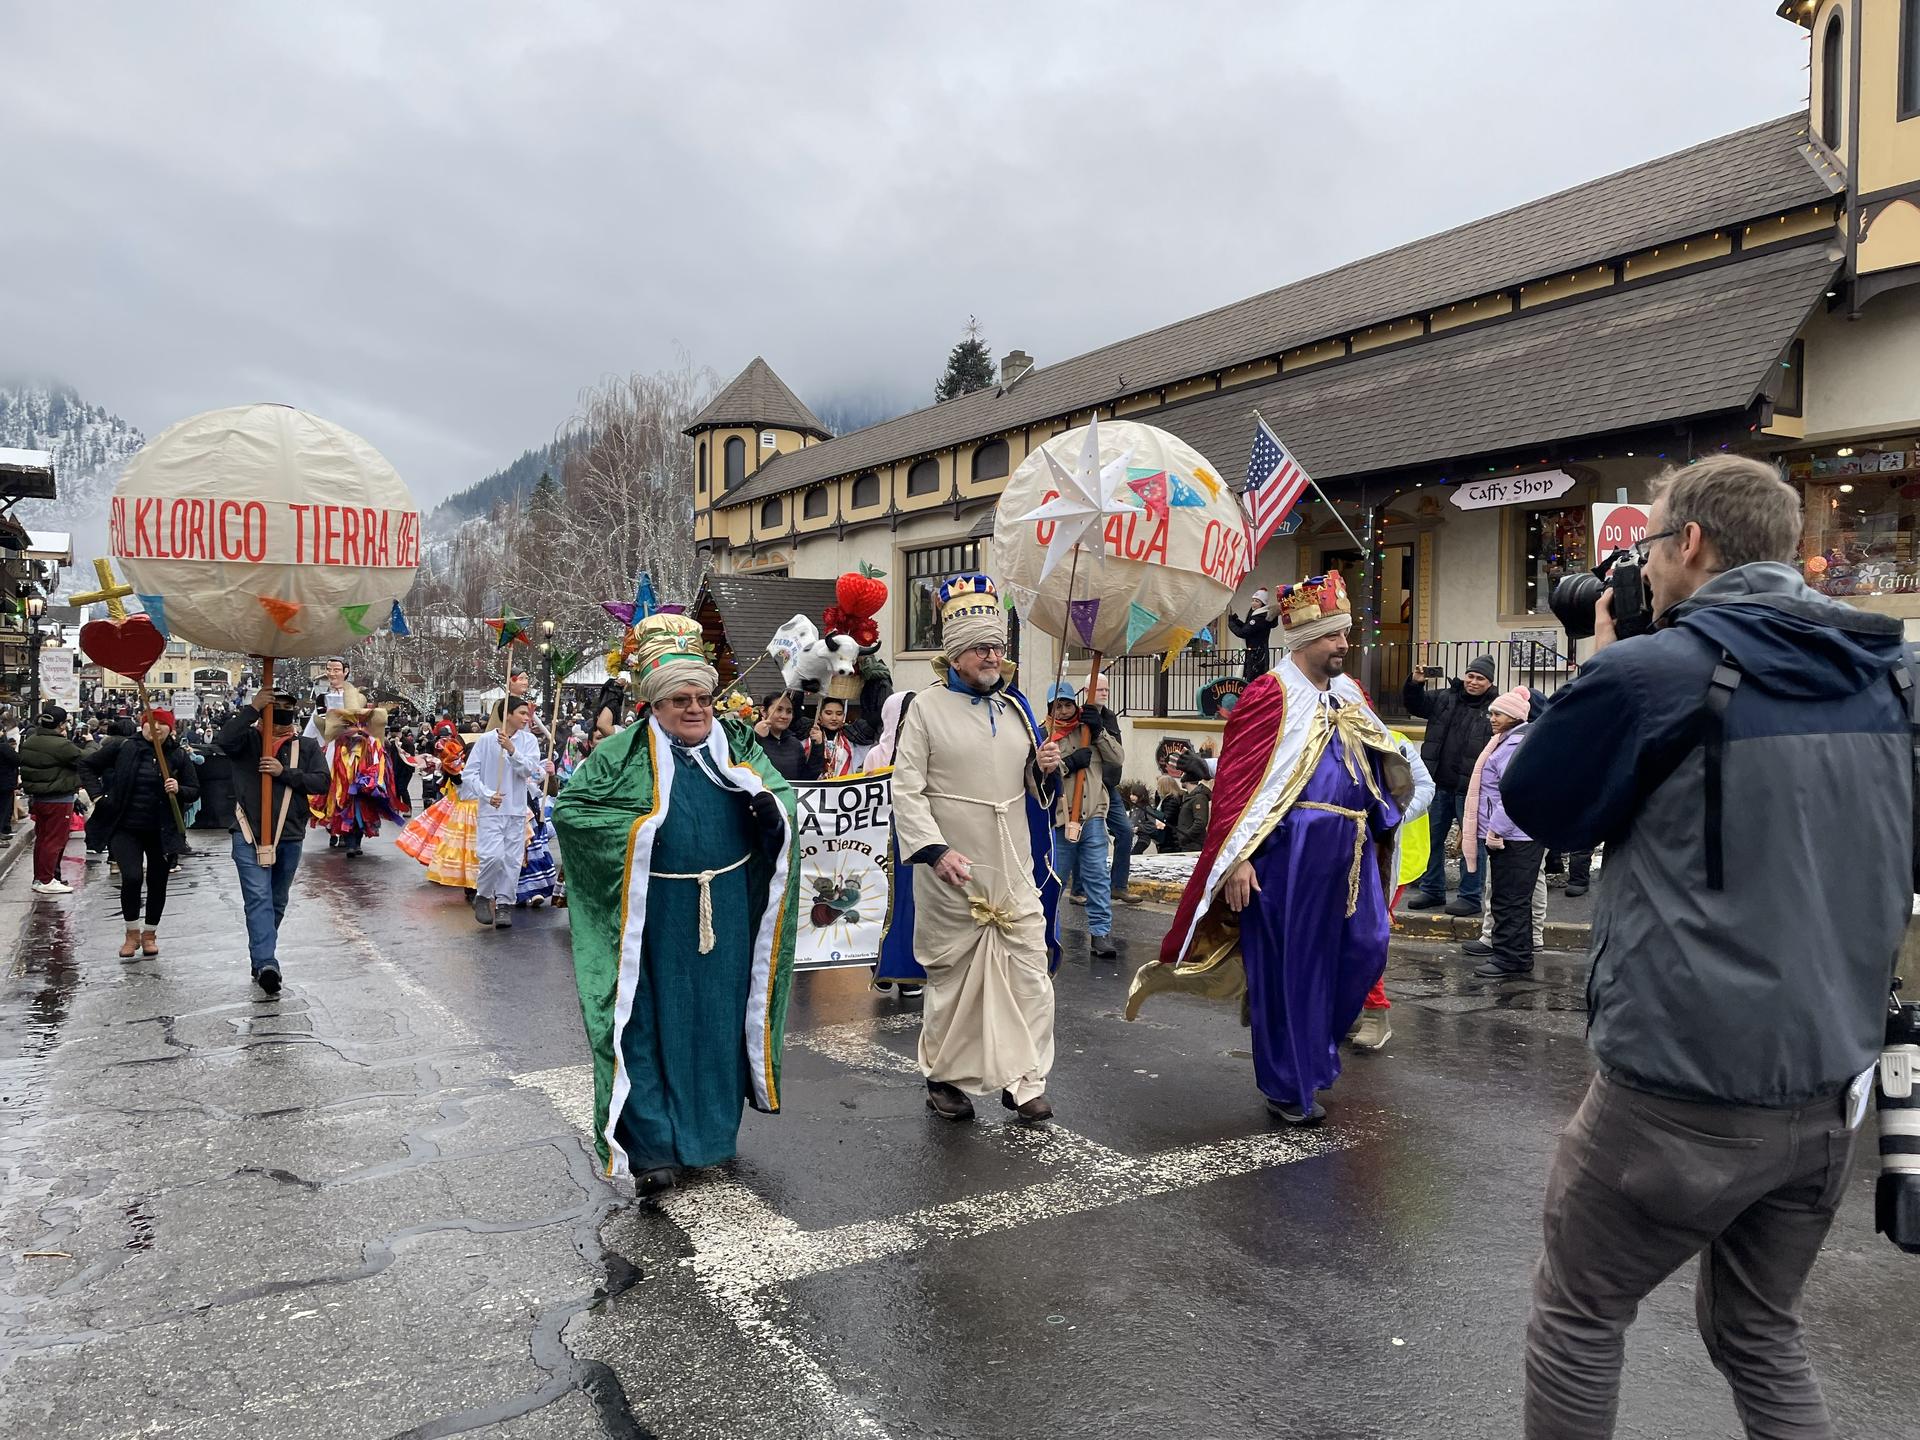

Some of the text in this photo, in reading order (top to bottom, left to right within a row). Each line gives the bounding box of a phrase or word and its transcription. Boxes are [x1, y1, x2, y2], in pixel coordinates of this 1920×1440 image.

[1468, 479, 1554, 501] Taffy Shop
[288, 503, 388, 566] TIERRA
[1605, 525, 1646, 542] DO NO
[835, 806, 889, 836] DEL
[822, 838, 873, 857] Tierra
